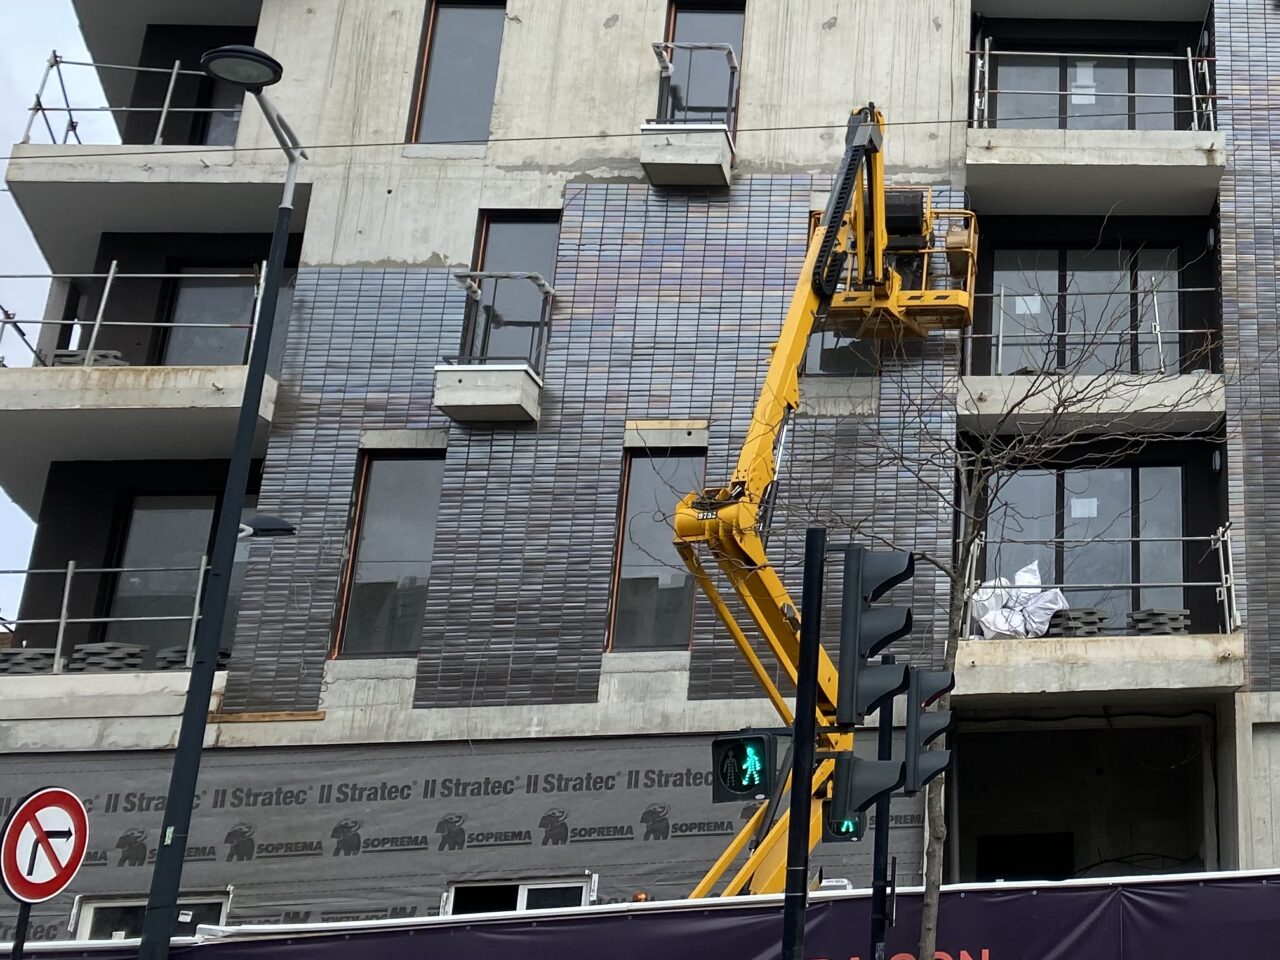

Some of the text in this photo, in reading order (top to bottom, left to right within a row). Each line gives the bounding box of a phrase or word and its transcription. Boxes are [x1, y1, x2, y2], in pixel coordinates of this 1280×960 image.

[256, 840, 323, 854] SOPREMA
[362, 835, 428, 849] SOPREMA
[467, 830, 532, 843] SOPREMA
[570, 825, 634, 838] SOPREMA
[671, 821, 734, 834] SOPREMA
